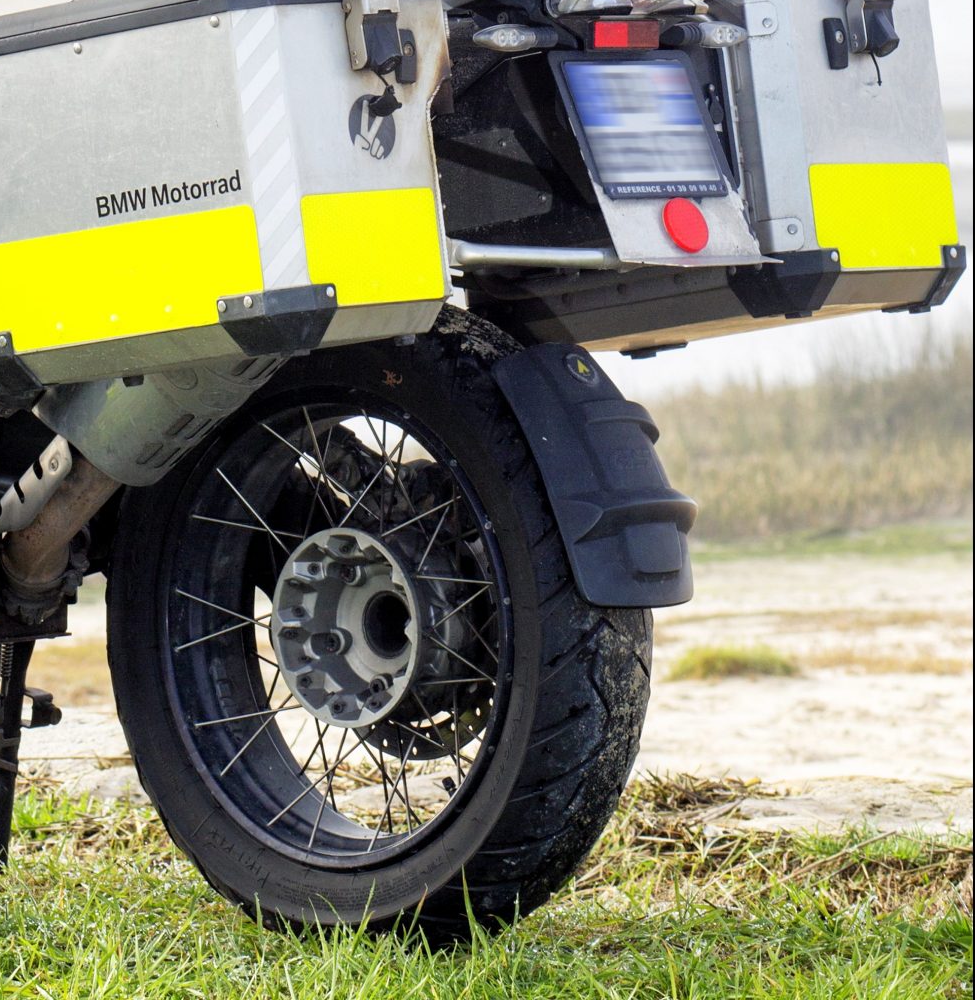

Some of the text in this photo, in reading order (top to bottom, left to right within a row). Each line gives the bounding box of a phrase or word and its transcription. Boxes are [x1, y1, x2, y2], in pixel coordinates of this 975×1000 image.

[95, 169, 242, 218] BMW Motorrad
[617, 185, 662, 194] REFERENCE
